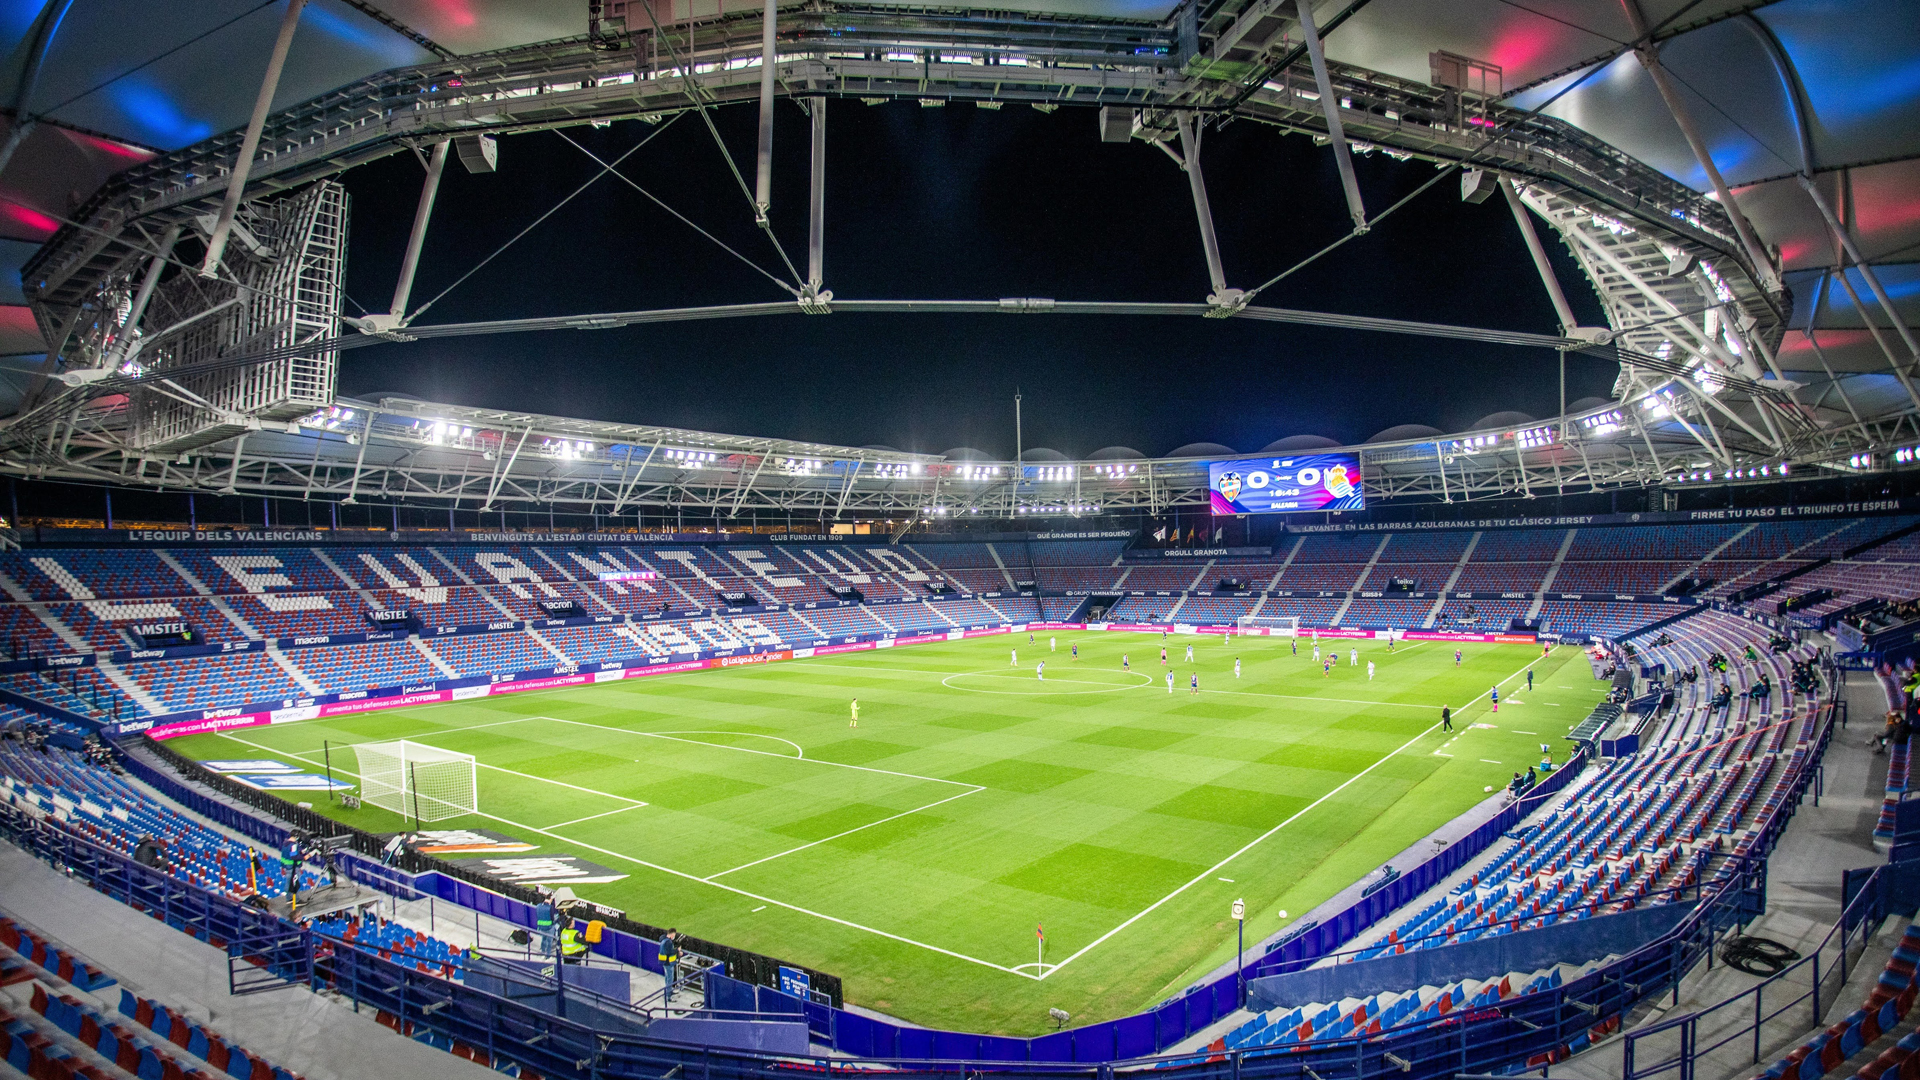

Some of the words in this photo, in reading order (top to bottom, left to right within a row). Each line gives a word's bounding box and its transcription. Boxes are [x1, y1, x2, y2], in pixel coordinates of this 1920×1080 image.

[1246, 471, 1269, 489] 0
[1297, 468, 1321, 486] 0
[1690, 511, 1725, 520] FIRME
[1727, 510, 1743, 518] TU
[1745, 508, 1776, 518] PASO
[1780, 507, 1795, 516] EL
[1797, 504, 1844, 515] TRIUNFO
[1846, 503, 1860, 512] TE
[1862, 499, 1900, 511] ESPERA
[1358, 523, 1375, 531] LAS
[1377, 522, 1413, 530] BARRAS
[1414, 520, 1476, 529] AZULGRANAS
[1478, 519, 1492, 527] DE
[1493, 519, 1506, 527] TU
[1508, 516, 1552, 526] CLÁSICO
[1554, 515, 1594, 525] JERSEY
[129, 531, 191, 542] L'EQUIP
[195, 531, 233, 541] DELS
[236, 531, 323, 541] VALENCIANS
[471, 533, 534, 542] BENVINGUTS
[536, 533, 543, 541] A
[545, 533, 585, 542] L'ESTADI
[587, 533, 618, 541] CIUTAT
[620, 533, 631, 541] DE
[633, 532, 674, 542] VALÈNCIA
[1100, 530, 1131, 538] PEQUEÑO
[1615, 594, 1635, 602] betway
[546, 619, 566, 627] betway
[595, 615, 613, 623] betway
[132, 622, 188, 636] AMSTEL
[487, 622, 515, 631] AMSTEL
[294, 636, 329, 646] macron
[1538, 632, 1562, 640] betway
[131, 650, 166, 660] betway
[728, 655, 748, 665] LaLiga
[47, 656, 84, 667] betway
[600, 662, 622, 670] betway
[649, 657, 669, 665] betway
[553, 665, 579, 675] AMSTEL
[676, 662, 703, 671] LACTYFERRIN
[524, 682, 545, 690] defensas
[553, 676, 585, 686] LACTYFERRIN
[338, 691, 368, 701] macron
[352, 702, 363, 711] tus
[363, 699, 390, 709] defensas
[389, 699, 401, 707] con
[400, 693, 441, 705] LACTYFERRIN
[203, 707, 243, 720] betway
[119, 719, 154, 734] betway
[201, 716, 255, 730] LACTYFERRIN
